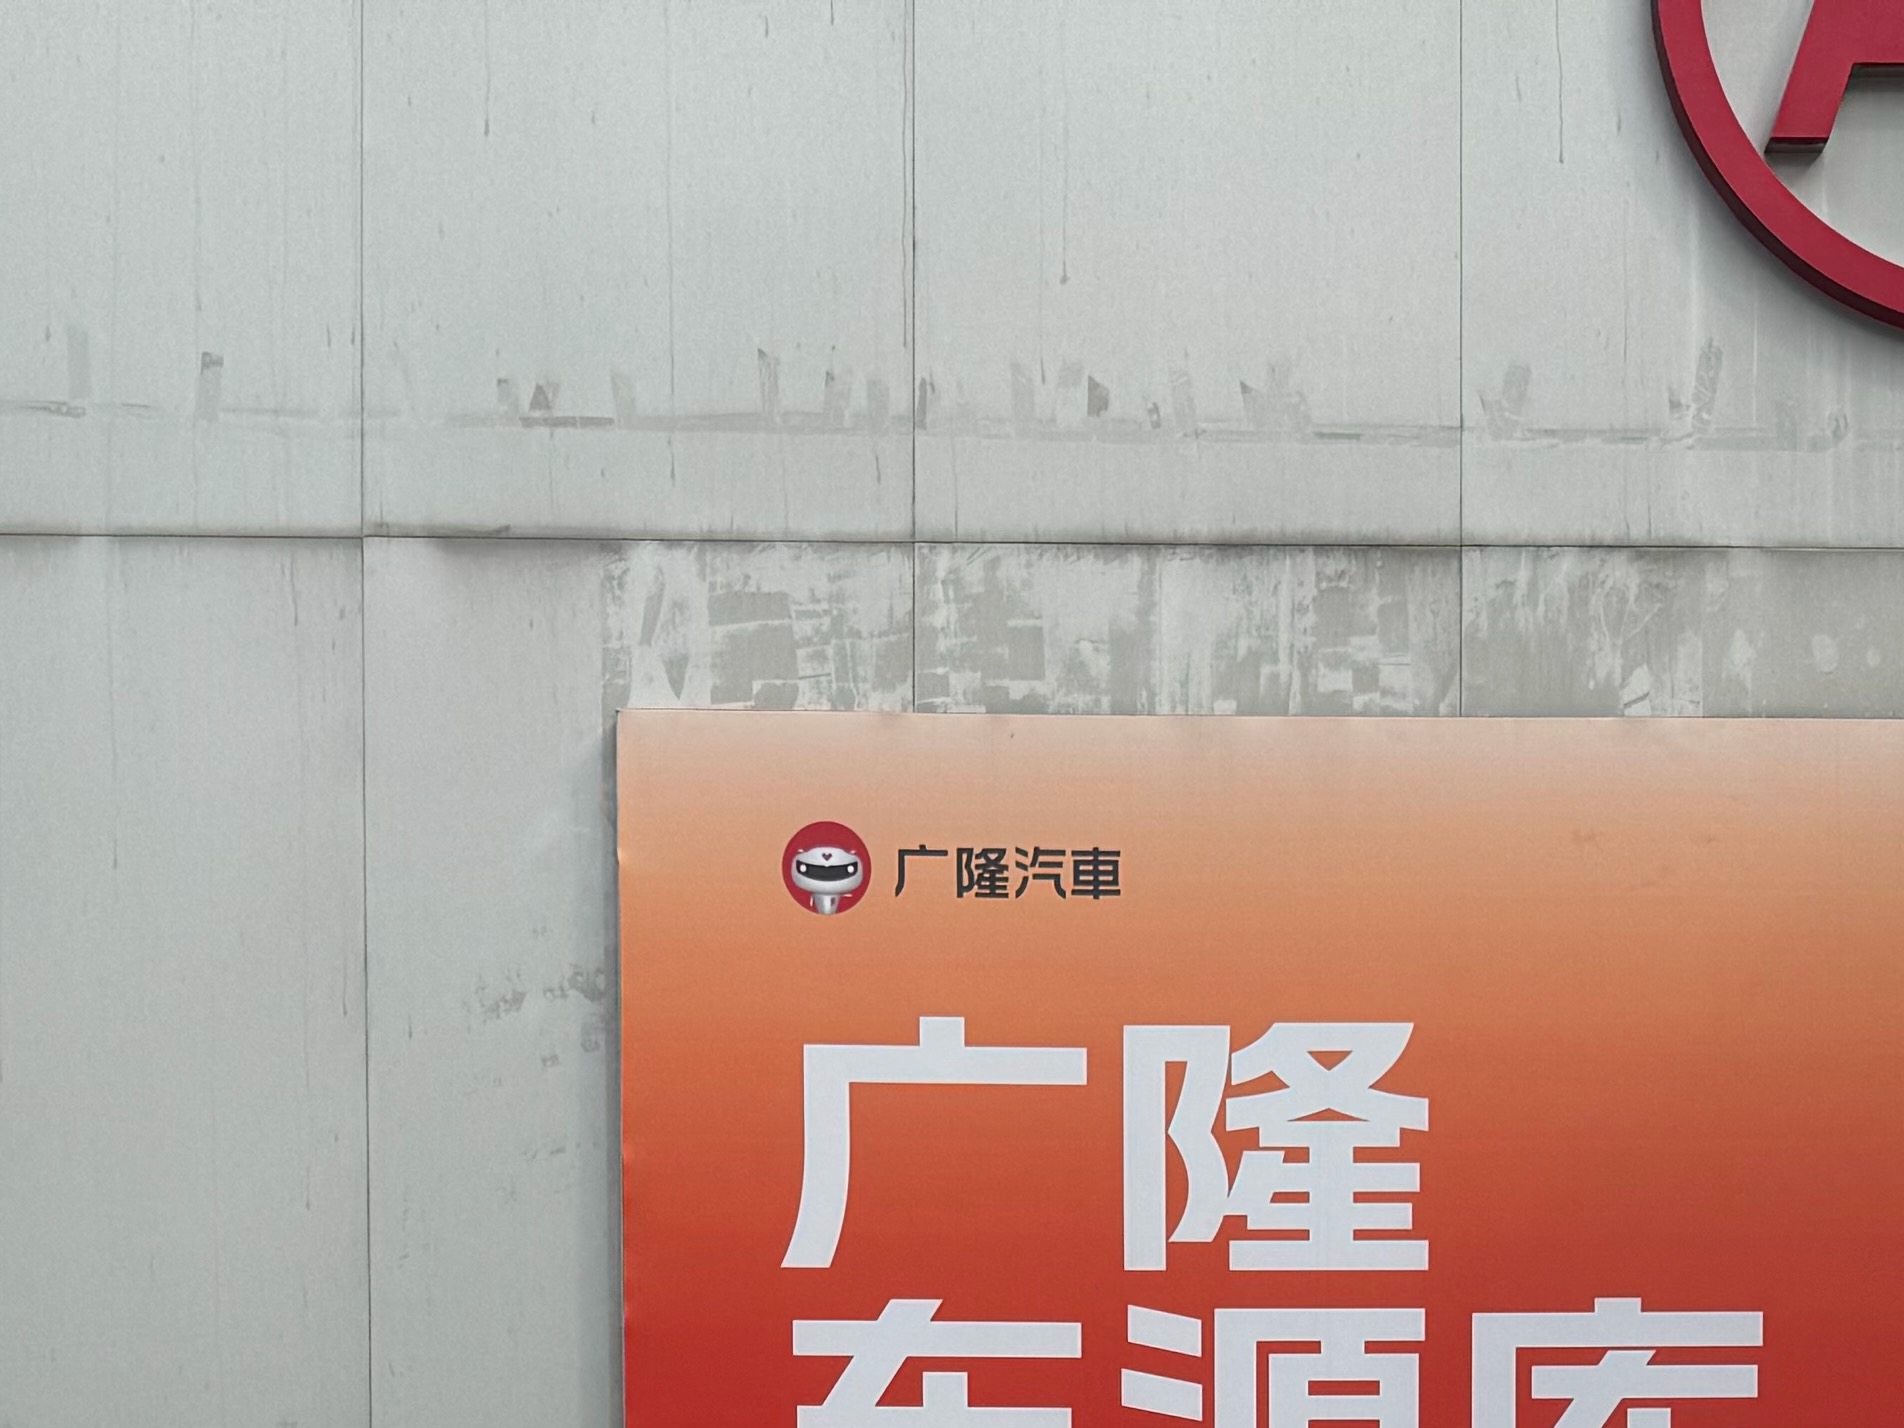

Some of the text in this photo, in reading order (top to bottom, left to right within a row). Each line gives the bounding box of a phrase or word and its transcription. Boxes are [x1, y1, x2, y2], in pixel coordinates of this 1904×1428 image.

[895, 844, 1122, 900] 广隆汽車
[780, 1015, 1430, 1272] 广隆
